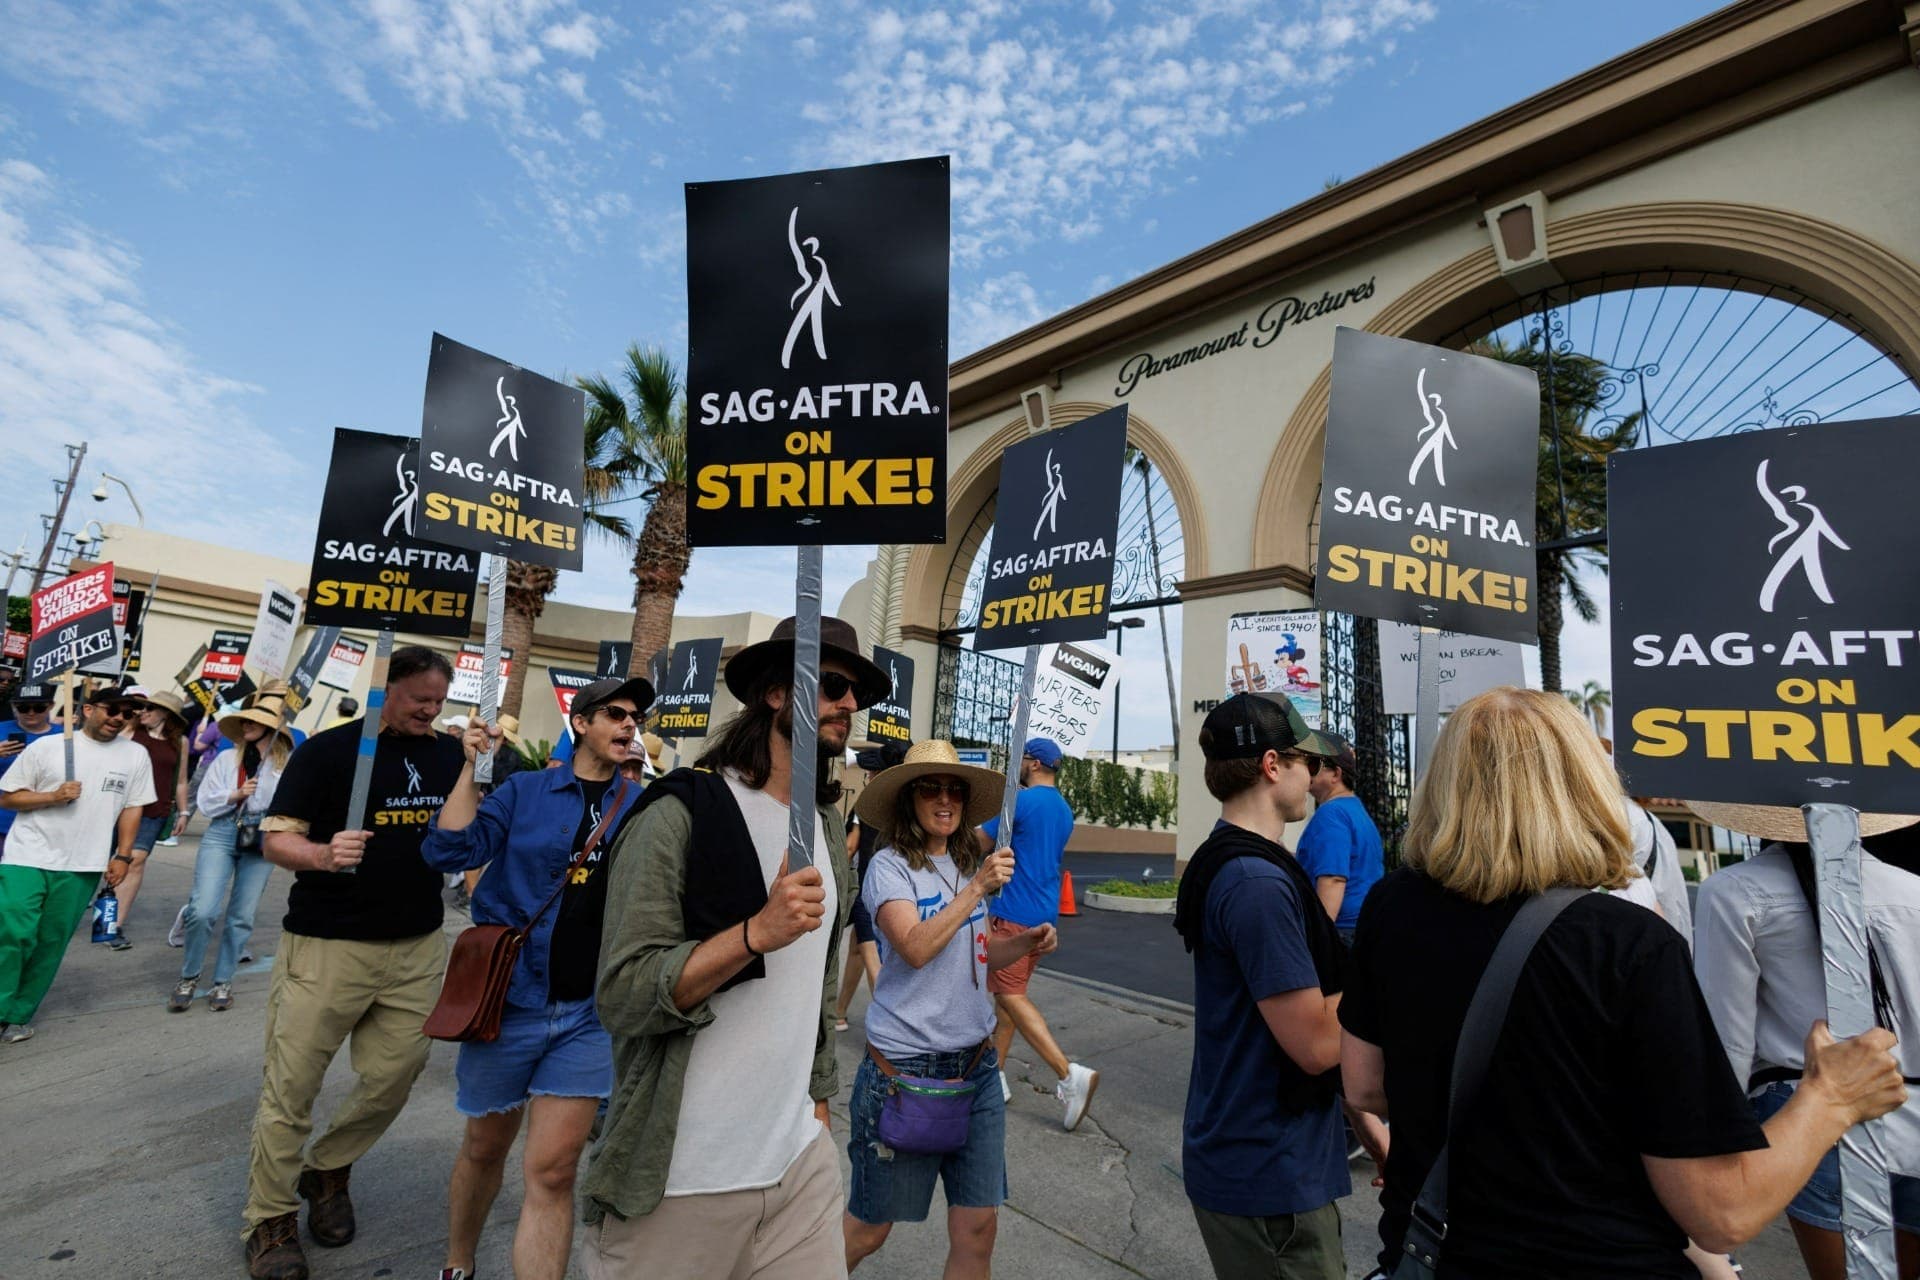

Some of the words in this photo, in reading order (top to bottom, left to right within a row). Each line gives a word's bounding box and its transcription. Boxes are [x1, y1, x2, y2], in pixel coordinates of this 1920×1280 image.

[1114, 322, 1248, 397] Paramount
[1253, 276, 1376, 348] Pictures
[785, 431, 832, 455] ON
[696, 457, 934, 510] STRIKE!
[490, 491, 519, 511] ON
[425, 492, 576, 551] STRIKE!
[1410, 534, 1448, 559] ON
[38, 571, 105, 608] WRITERS
[379, 570, 410, 585] ON
[1028, 573, 1053, 591] ON
[1327, 544, 1528, 613] STRIKE!
[40, 589, 87, 618] GUILD
[314, 579, 469, 618] STRIKE!
[981, 584, 1105, 629] STRIKE!
[37, 593, 108, 633] AMERICA
[58, 624, 79, 644] ON
[1282, 622, 1316, 632] 1940!
[32, 629, 113, 678] STRIKE
[1461, 648, 1503, 658] BREAK
[1632, 630, 1920, 667] SAG·AFT
[1058, 650, 1106, 680] WGAW
[1439, 669, 1456, 679] OU
[1037, 673, 1101, 715] WRITERS
[1776, 678, 1856, 704] ON
[1028, 697, 1088, 736] ACTORS
[1054, 699, 1064, 713] &
[660, 714, 708, 728] STRIKE!
[869, 719, 909, 740] STRIKE!
[374, 809, 434, 826] STRO
